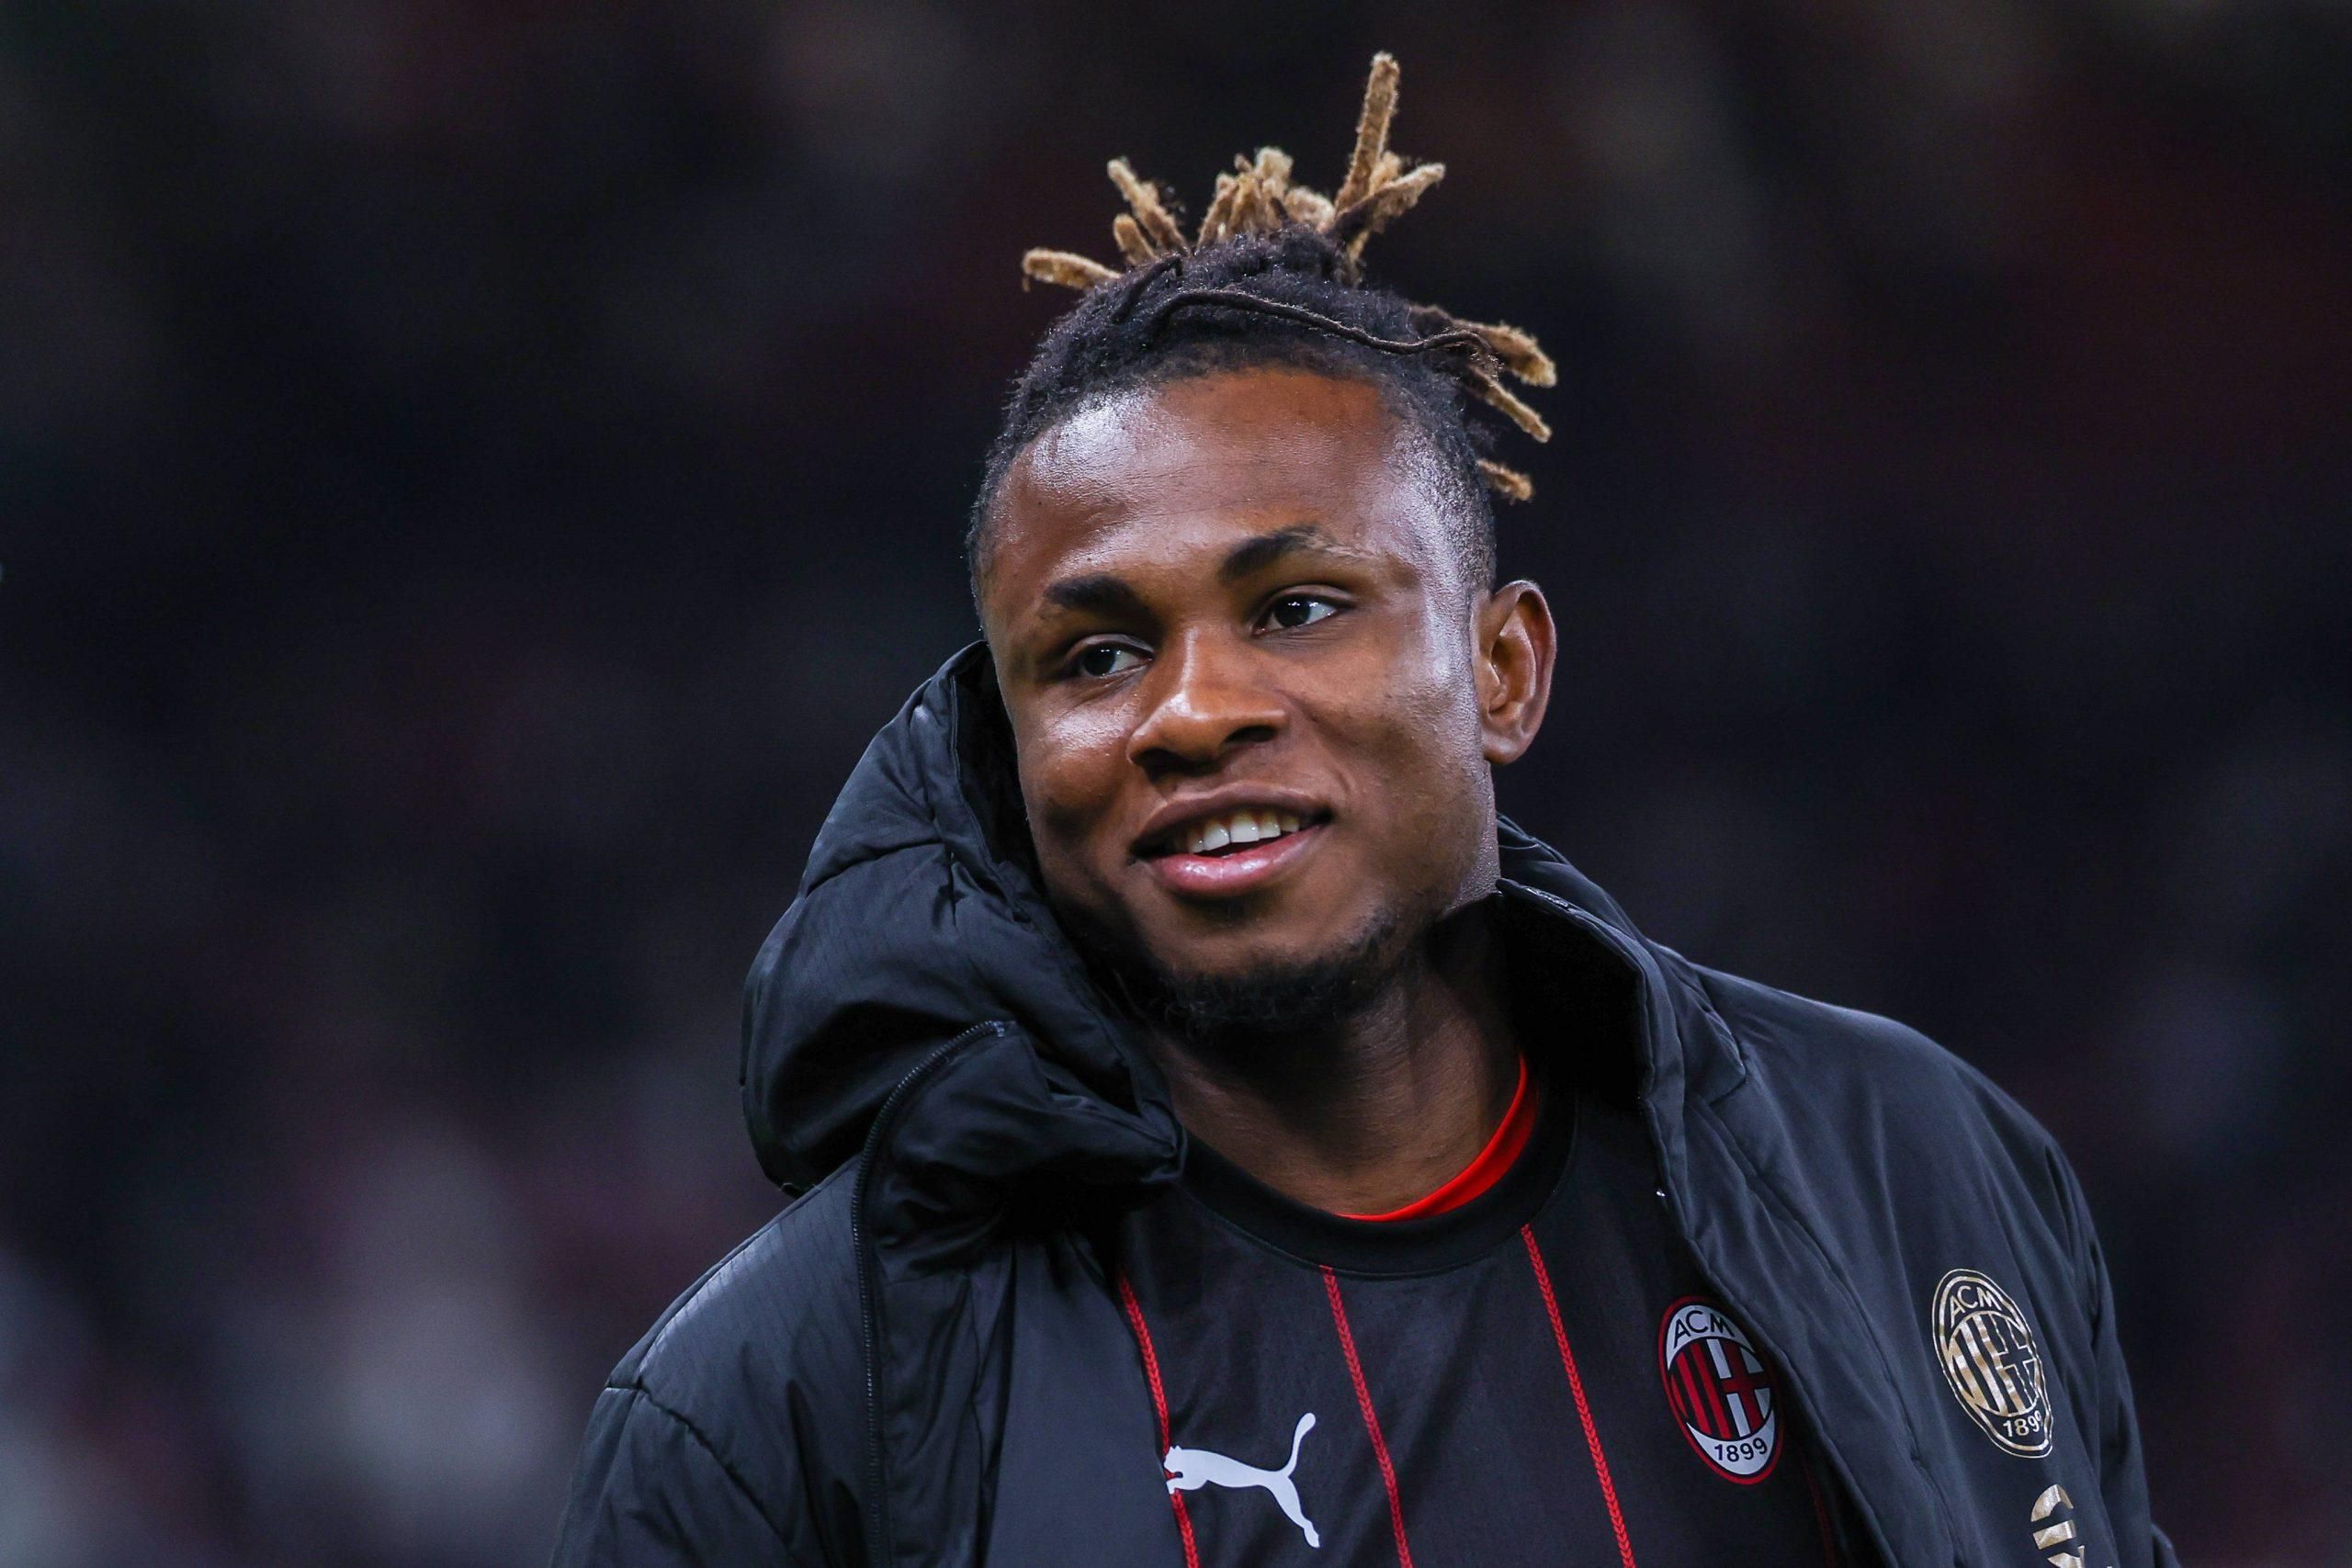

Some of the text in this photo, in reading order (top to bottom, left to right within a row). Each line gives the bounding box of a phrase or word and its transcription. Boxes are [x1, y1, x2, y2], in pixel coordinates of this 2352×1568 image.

[1950, 1285, 2002, 1328] ACM
[1673, 1310, 1736, 1348] ACM
[1714, 1437, 1769, 1462] 1899
